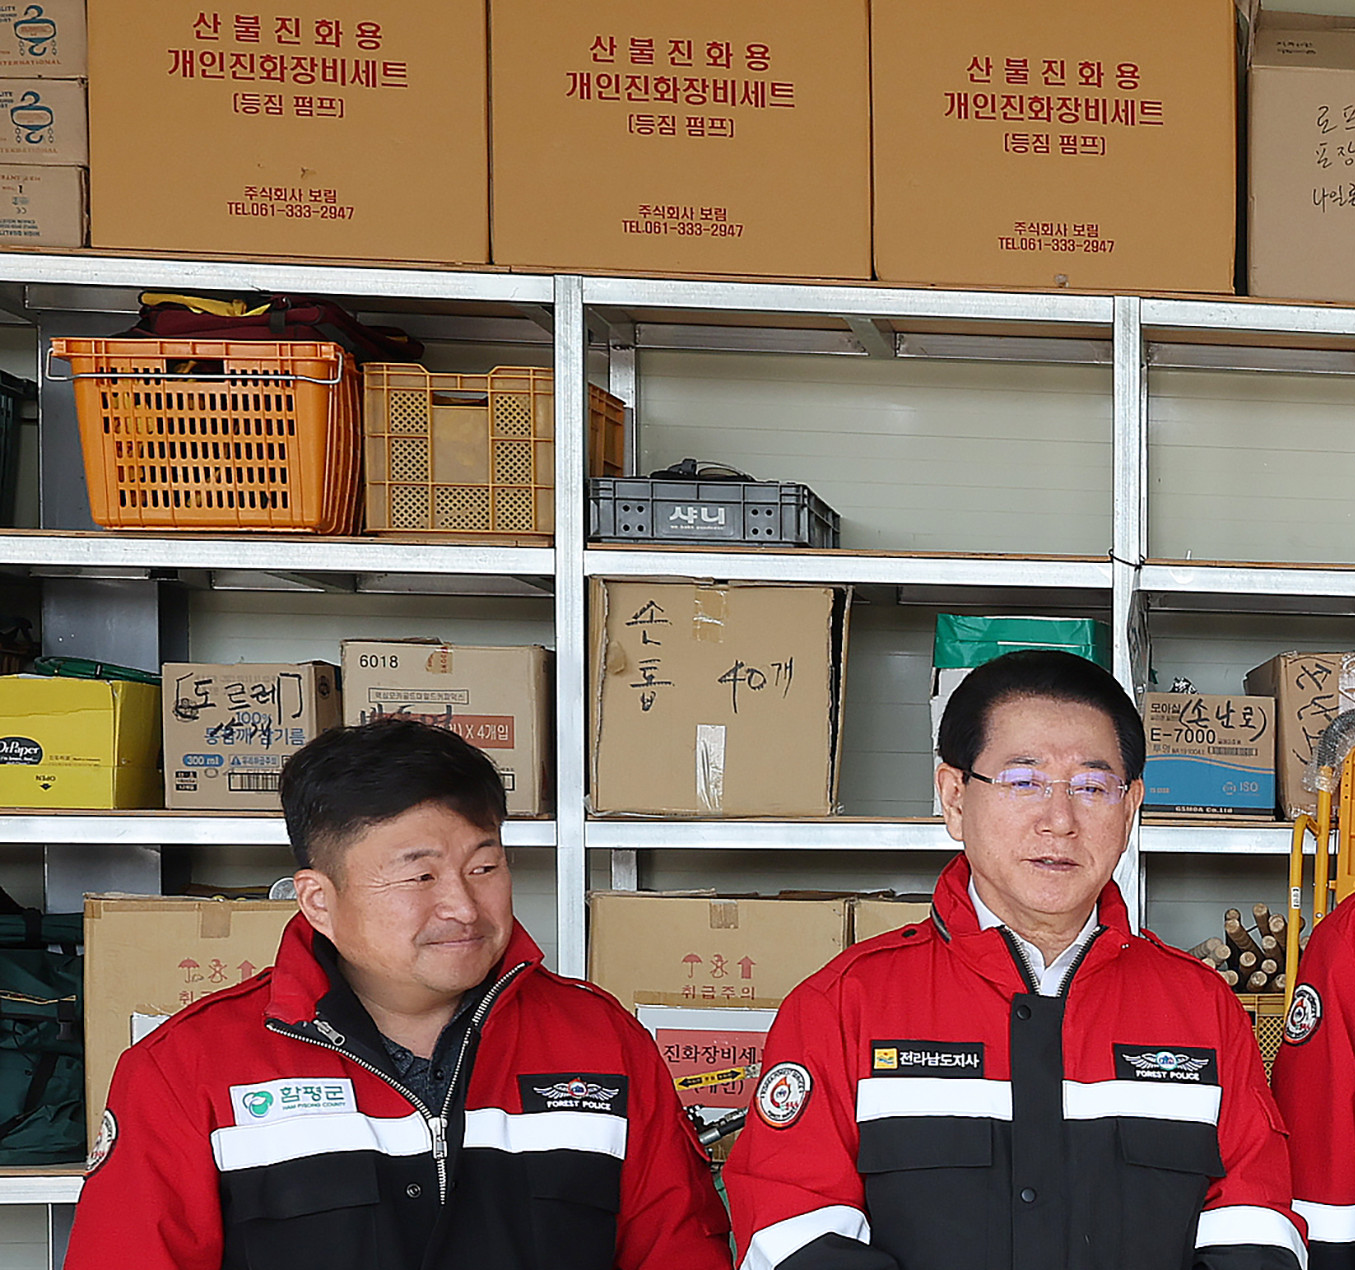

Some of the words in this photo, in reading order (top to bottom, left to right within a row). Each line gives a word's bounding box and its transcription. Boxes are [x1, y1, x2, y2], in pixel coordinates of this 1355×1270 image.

[167, 48, 409, 90] 개인진화장비세트
[566, 70, 796, 110] 개인진화장비세트
[943, 90, 1164, 128] 개인진화장비세트
[244, 186, 302, 203] 주식회사
[308, 188, 337, 204] 보림
[226, 201, 356, 222] TEL.061-333-2947
[638, 204, 694, 221] 주식회사
[700, 206, 728, 222] 보림
[622, 218, 743, 238] TEL.061-333-2947
[1014, 221, 1066, 237] 주식회사
[1072, 222, 1099, 238] 보림
[998, 236, 1115, 255] TEL.061-333-2947
[670, 506, 724, 524] 샤니
[360, 655, 398, 668] 6018
[718, 657, 794, 713] 40개
[478, 726, 508, 741] 4개입
[1151, 728, 1216, 744] E-7000
[1240, 782, 1259, 792] ISO
[681, 985, 756, 1000] 취급주의
[900, 1051, 980, 1070] 전라남도지사
[1136, 1070, 1166, 1078] FOREST
[1169, 1072, 1200, 1080] POLICE
[280, 1086, 345, 1104] 함평군
[547, 1100, 579, 1110] FOREST
[582, 1101, 612, 1111] POLICE
